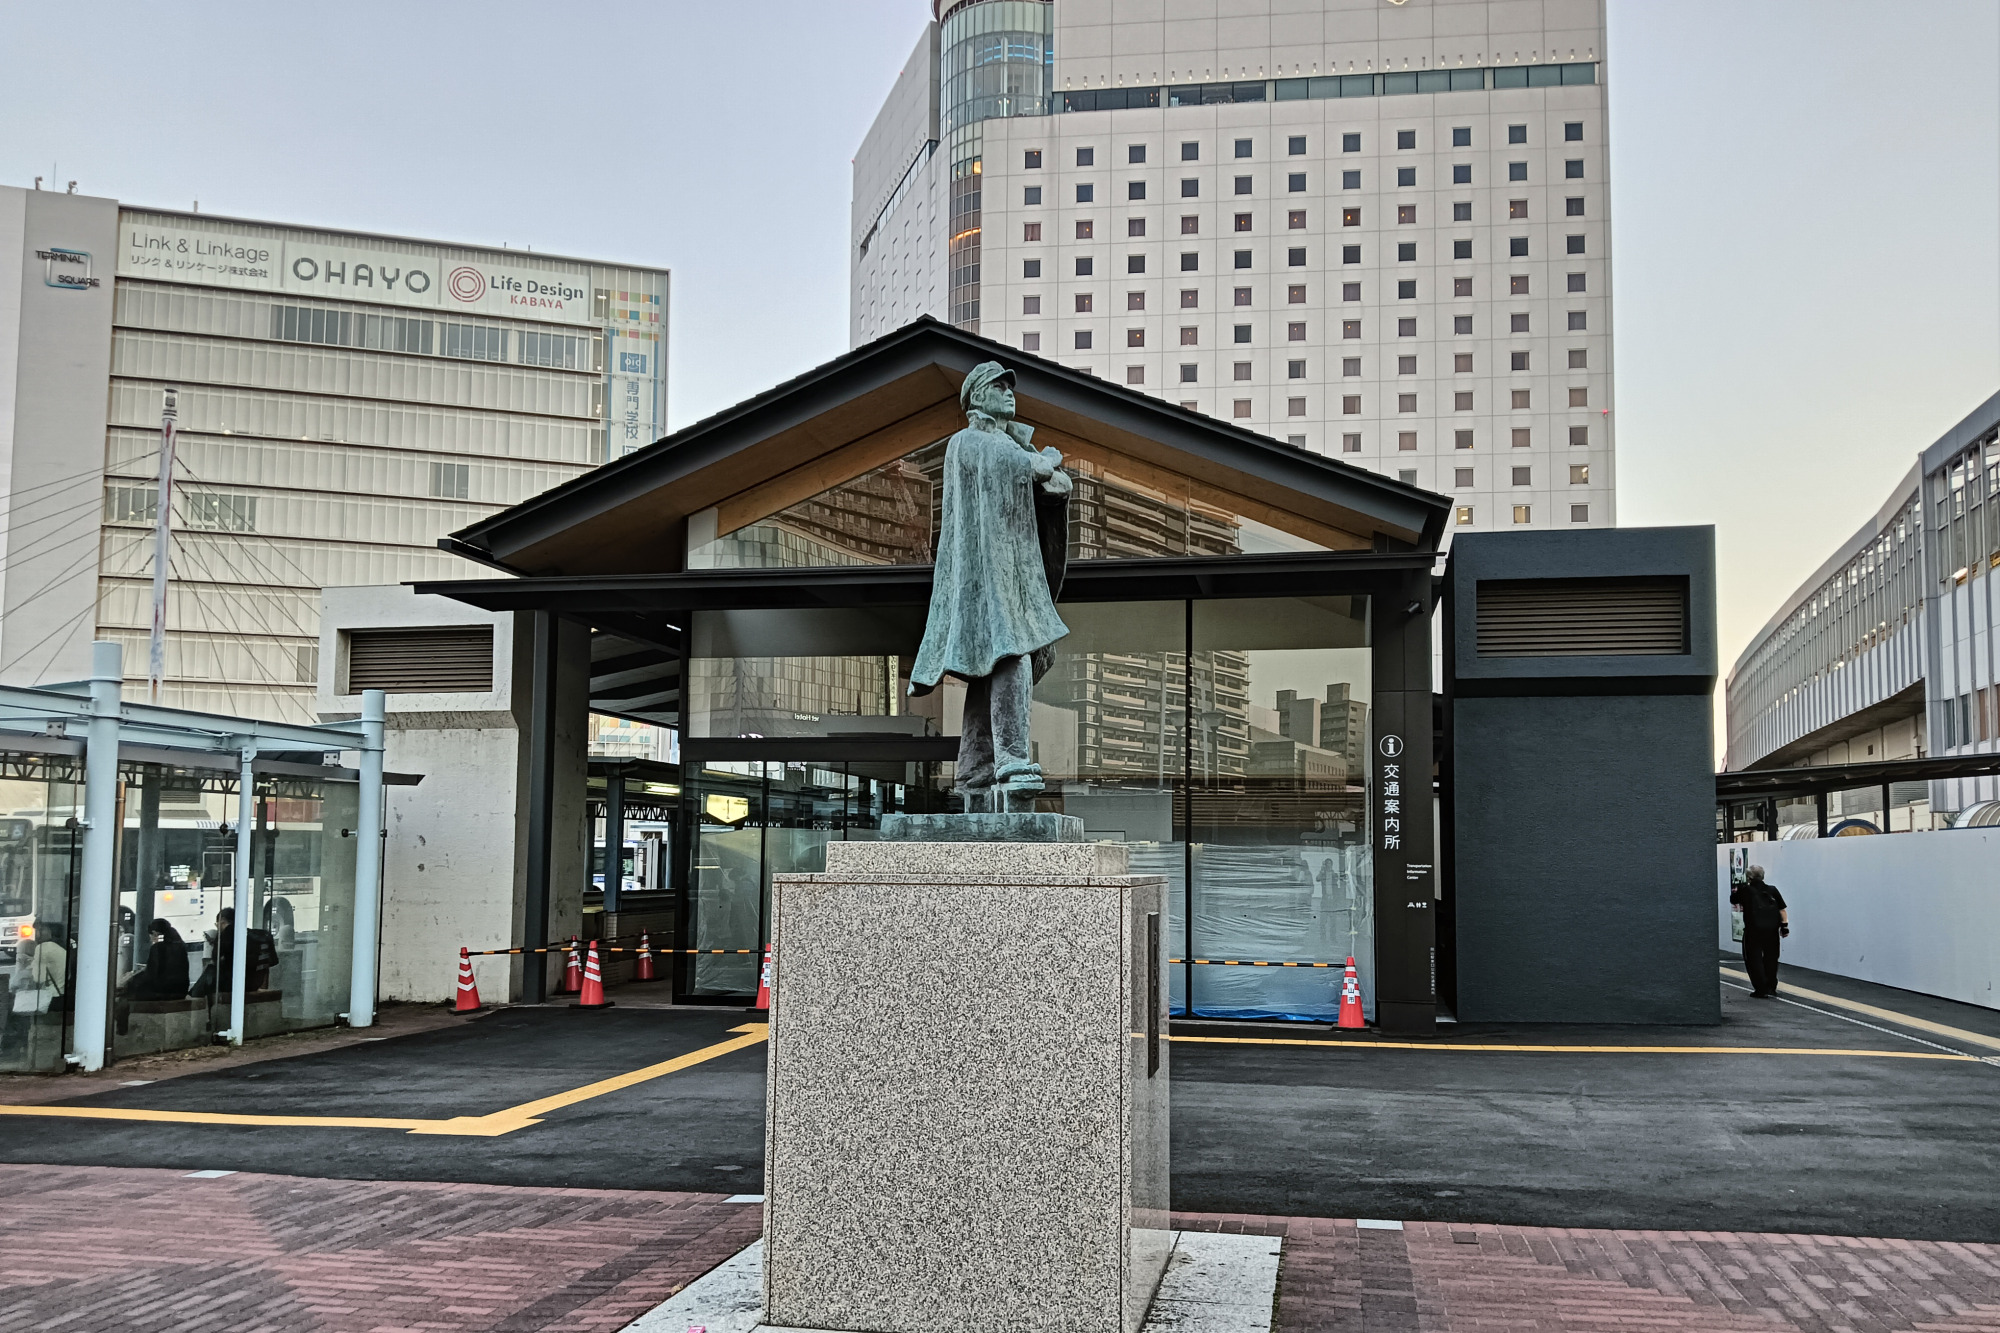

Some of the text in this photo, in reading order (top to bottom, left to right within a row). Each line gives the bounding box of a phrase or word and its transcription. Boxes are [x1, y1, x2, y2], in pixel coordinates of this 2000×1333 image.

[35, 250, 85, 264] TERMINAL
[132, 232, 270, 264] Link & Linkage
[131, 255, 269, 279] リンク & リンケージ株式会社
[292, 257, 431, 294] OHAYO
[57, 274, 101, 288] SQUARE
[490, 275, 584, 301] Life Design
[510, 294, 564, 310] KABAYA
[1383, 763, 1401, 850] 交通案内所
